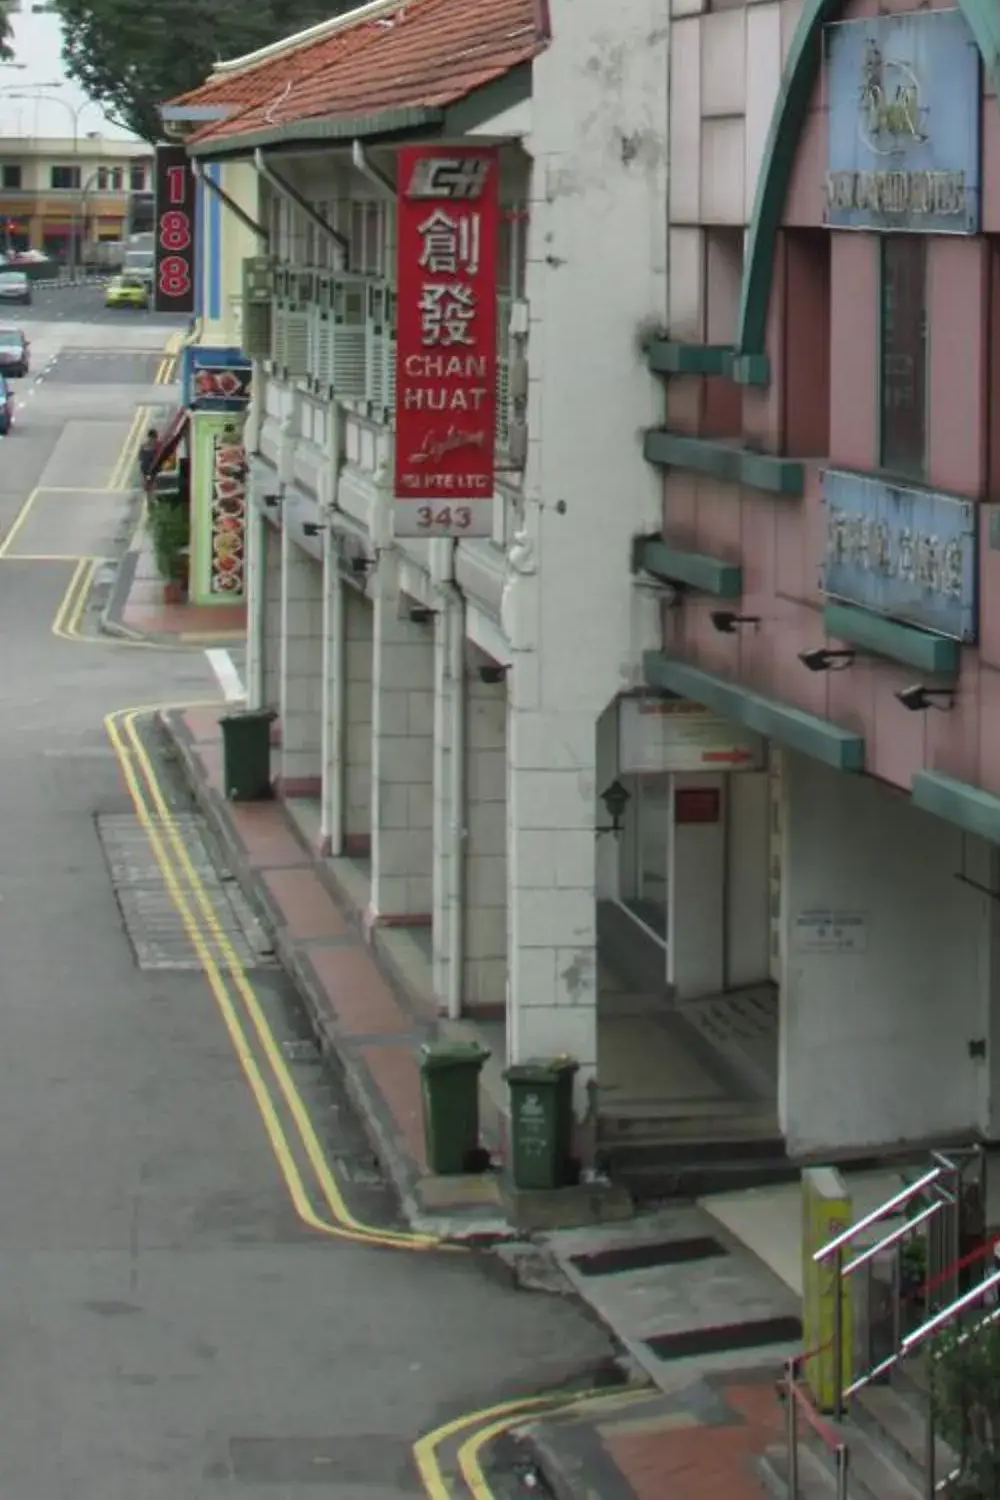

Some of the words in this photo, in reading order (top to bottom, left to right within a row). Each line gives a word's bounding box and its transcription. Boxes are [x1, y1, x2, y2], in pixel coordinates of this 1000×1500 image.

[158, 164, 192, 297] 188
[416, 206, 482, 346] 創發
[405, 353, 487, 378] CHAN
[403, 386, 488, 411] HUAT
[415, 504, 474, 530] 343
